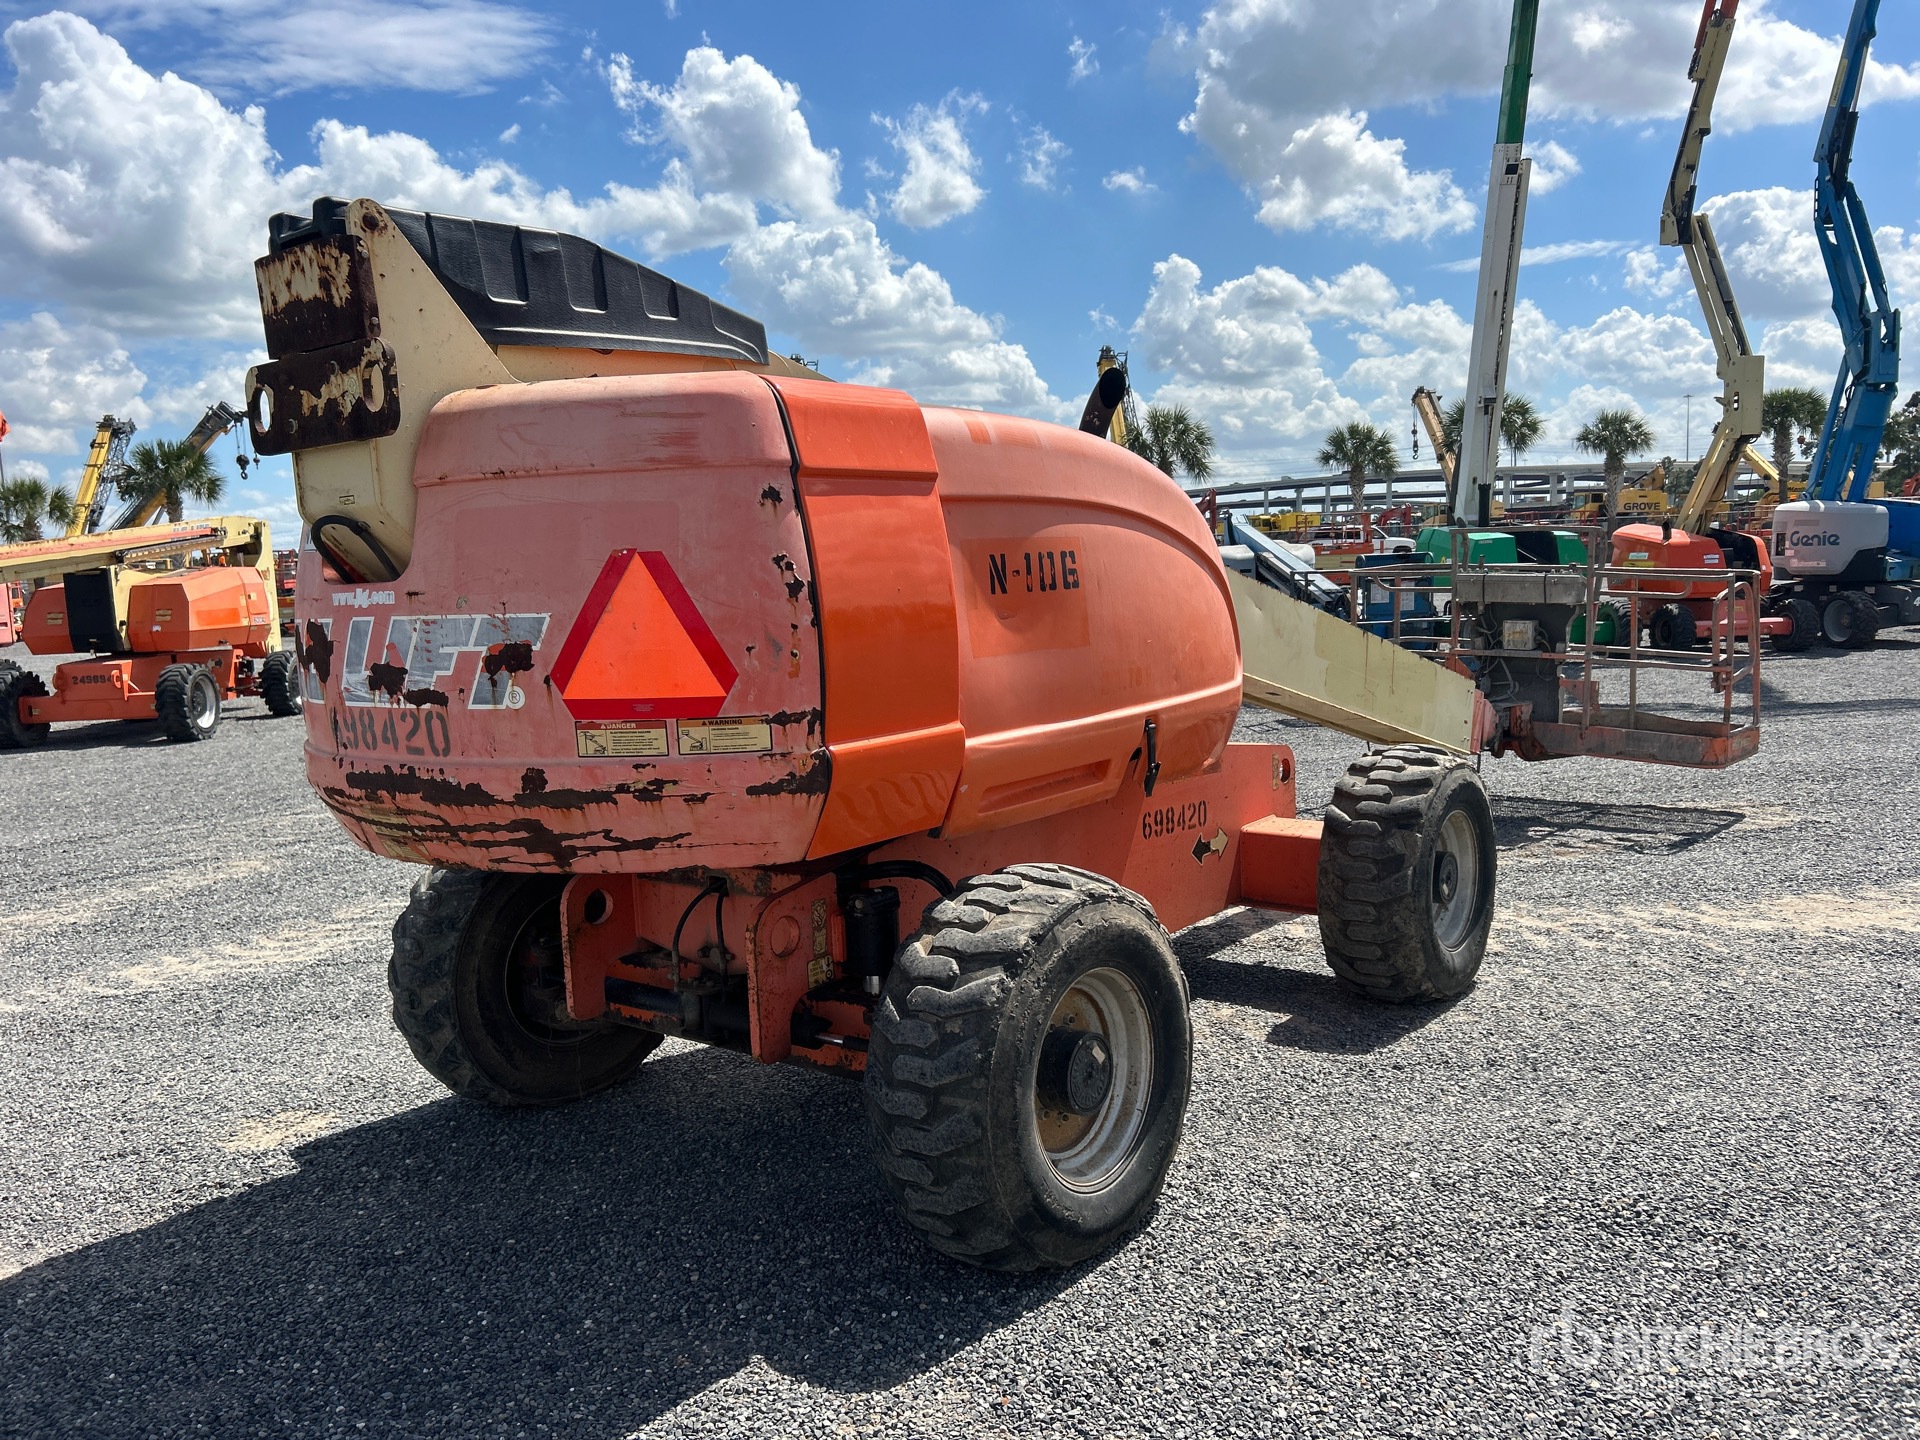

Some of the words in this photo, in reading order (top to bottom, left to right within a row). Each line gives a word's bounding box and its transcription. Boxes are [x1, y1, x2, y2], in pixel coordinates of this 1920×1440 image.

[1623, 502, 1661, 511] GROVE
[1790, 531, 1840, 546] Genie
[332, 588, 395, 608] www.jlg.com
[1142, 800, 1207, 840] 698420
